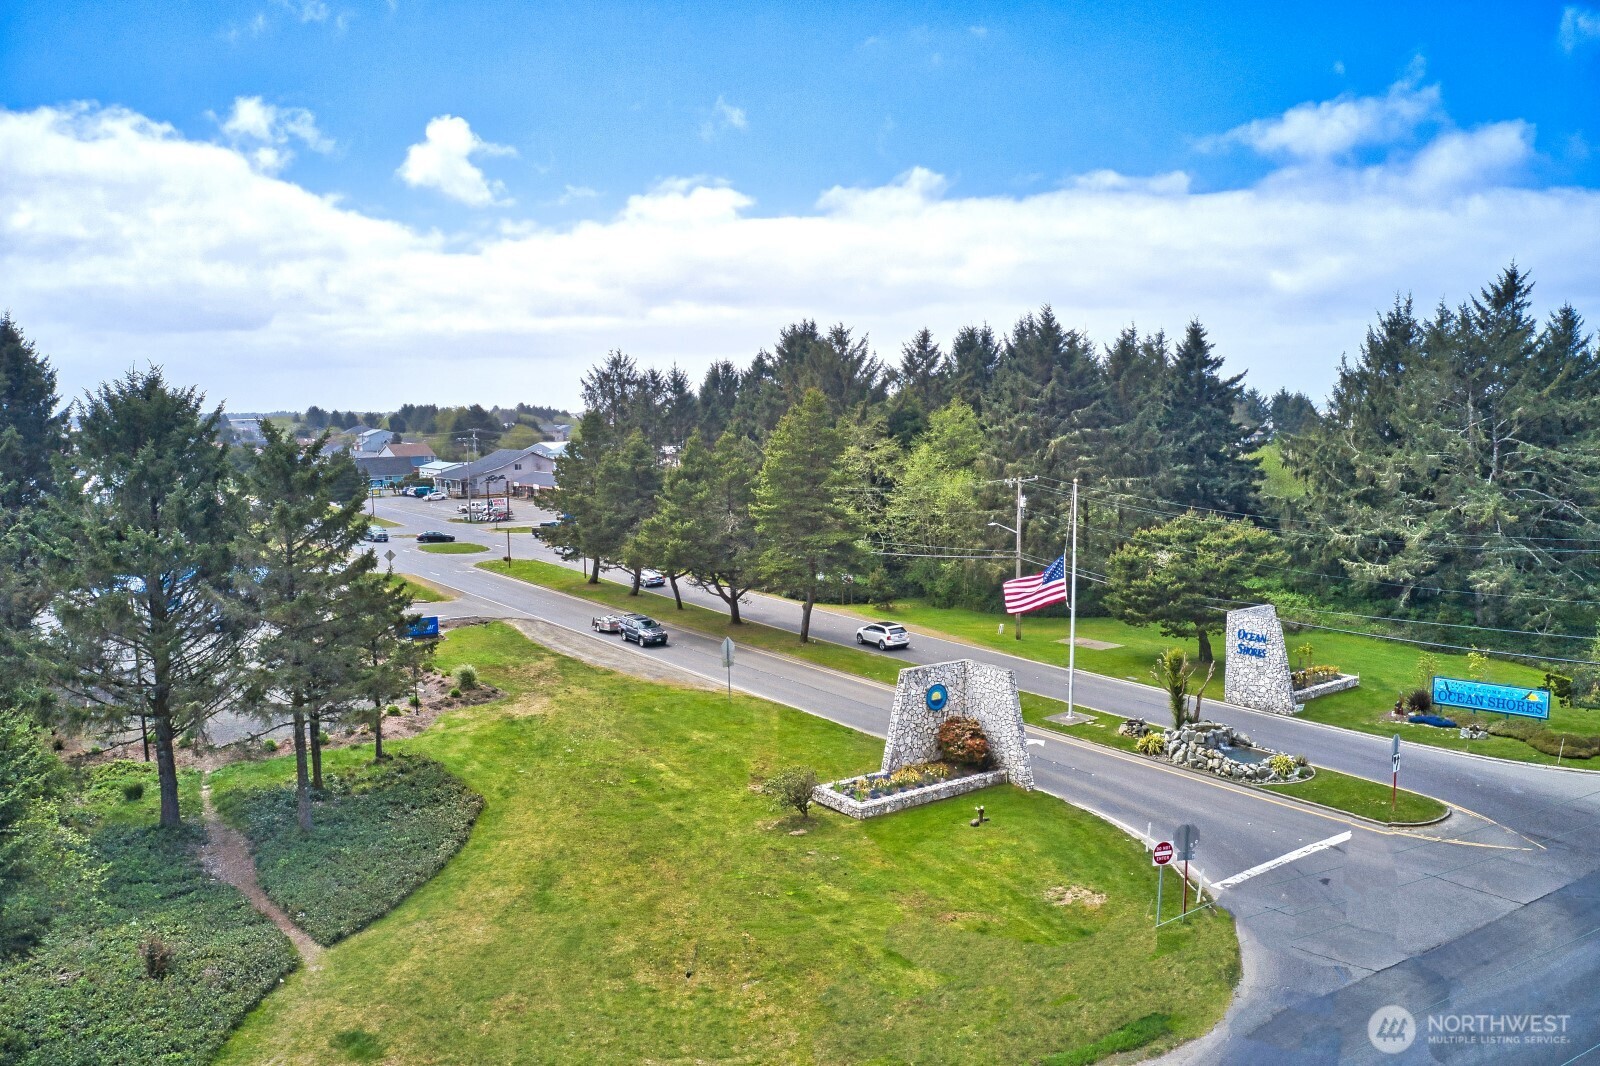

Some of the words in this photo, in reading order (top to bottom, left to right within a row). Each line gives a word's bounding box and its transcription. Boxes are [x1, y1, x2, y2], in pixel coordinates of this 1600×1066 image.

[1237, 629, 1267, 643] OCEAN
[1237, 643, 1267, 658] SHORES
[1438, 690, 1484, 706] OCEAN
[1487, 696, 1543, 714] SHORES
